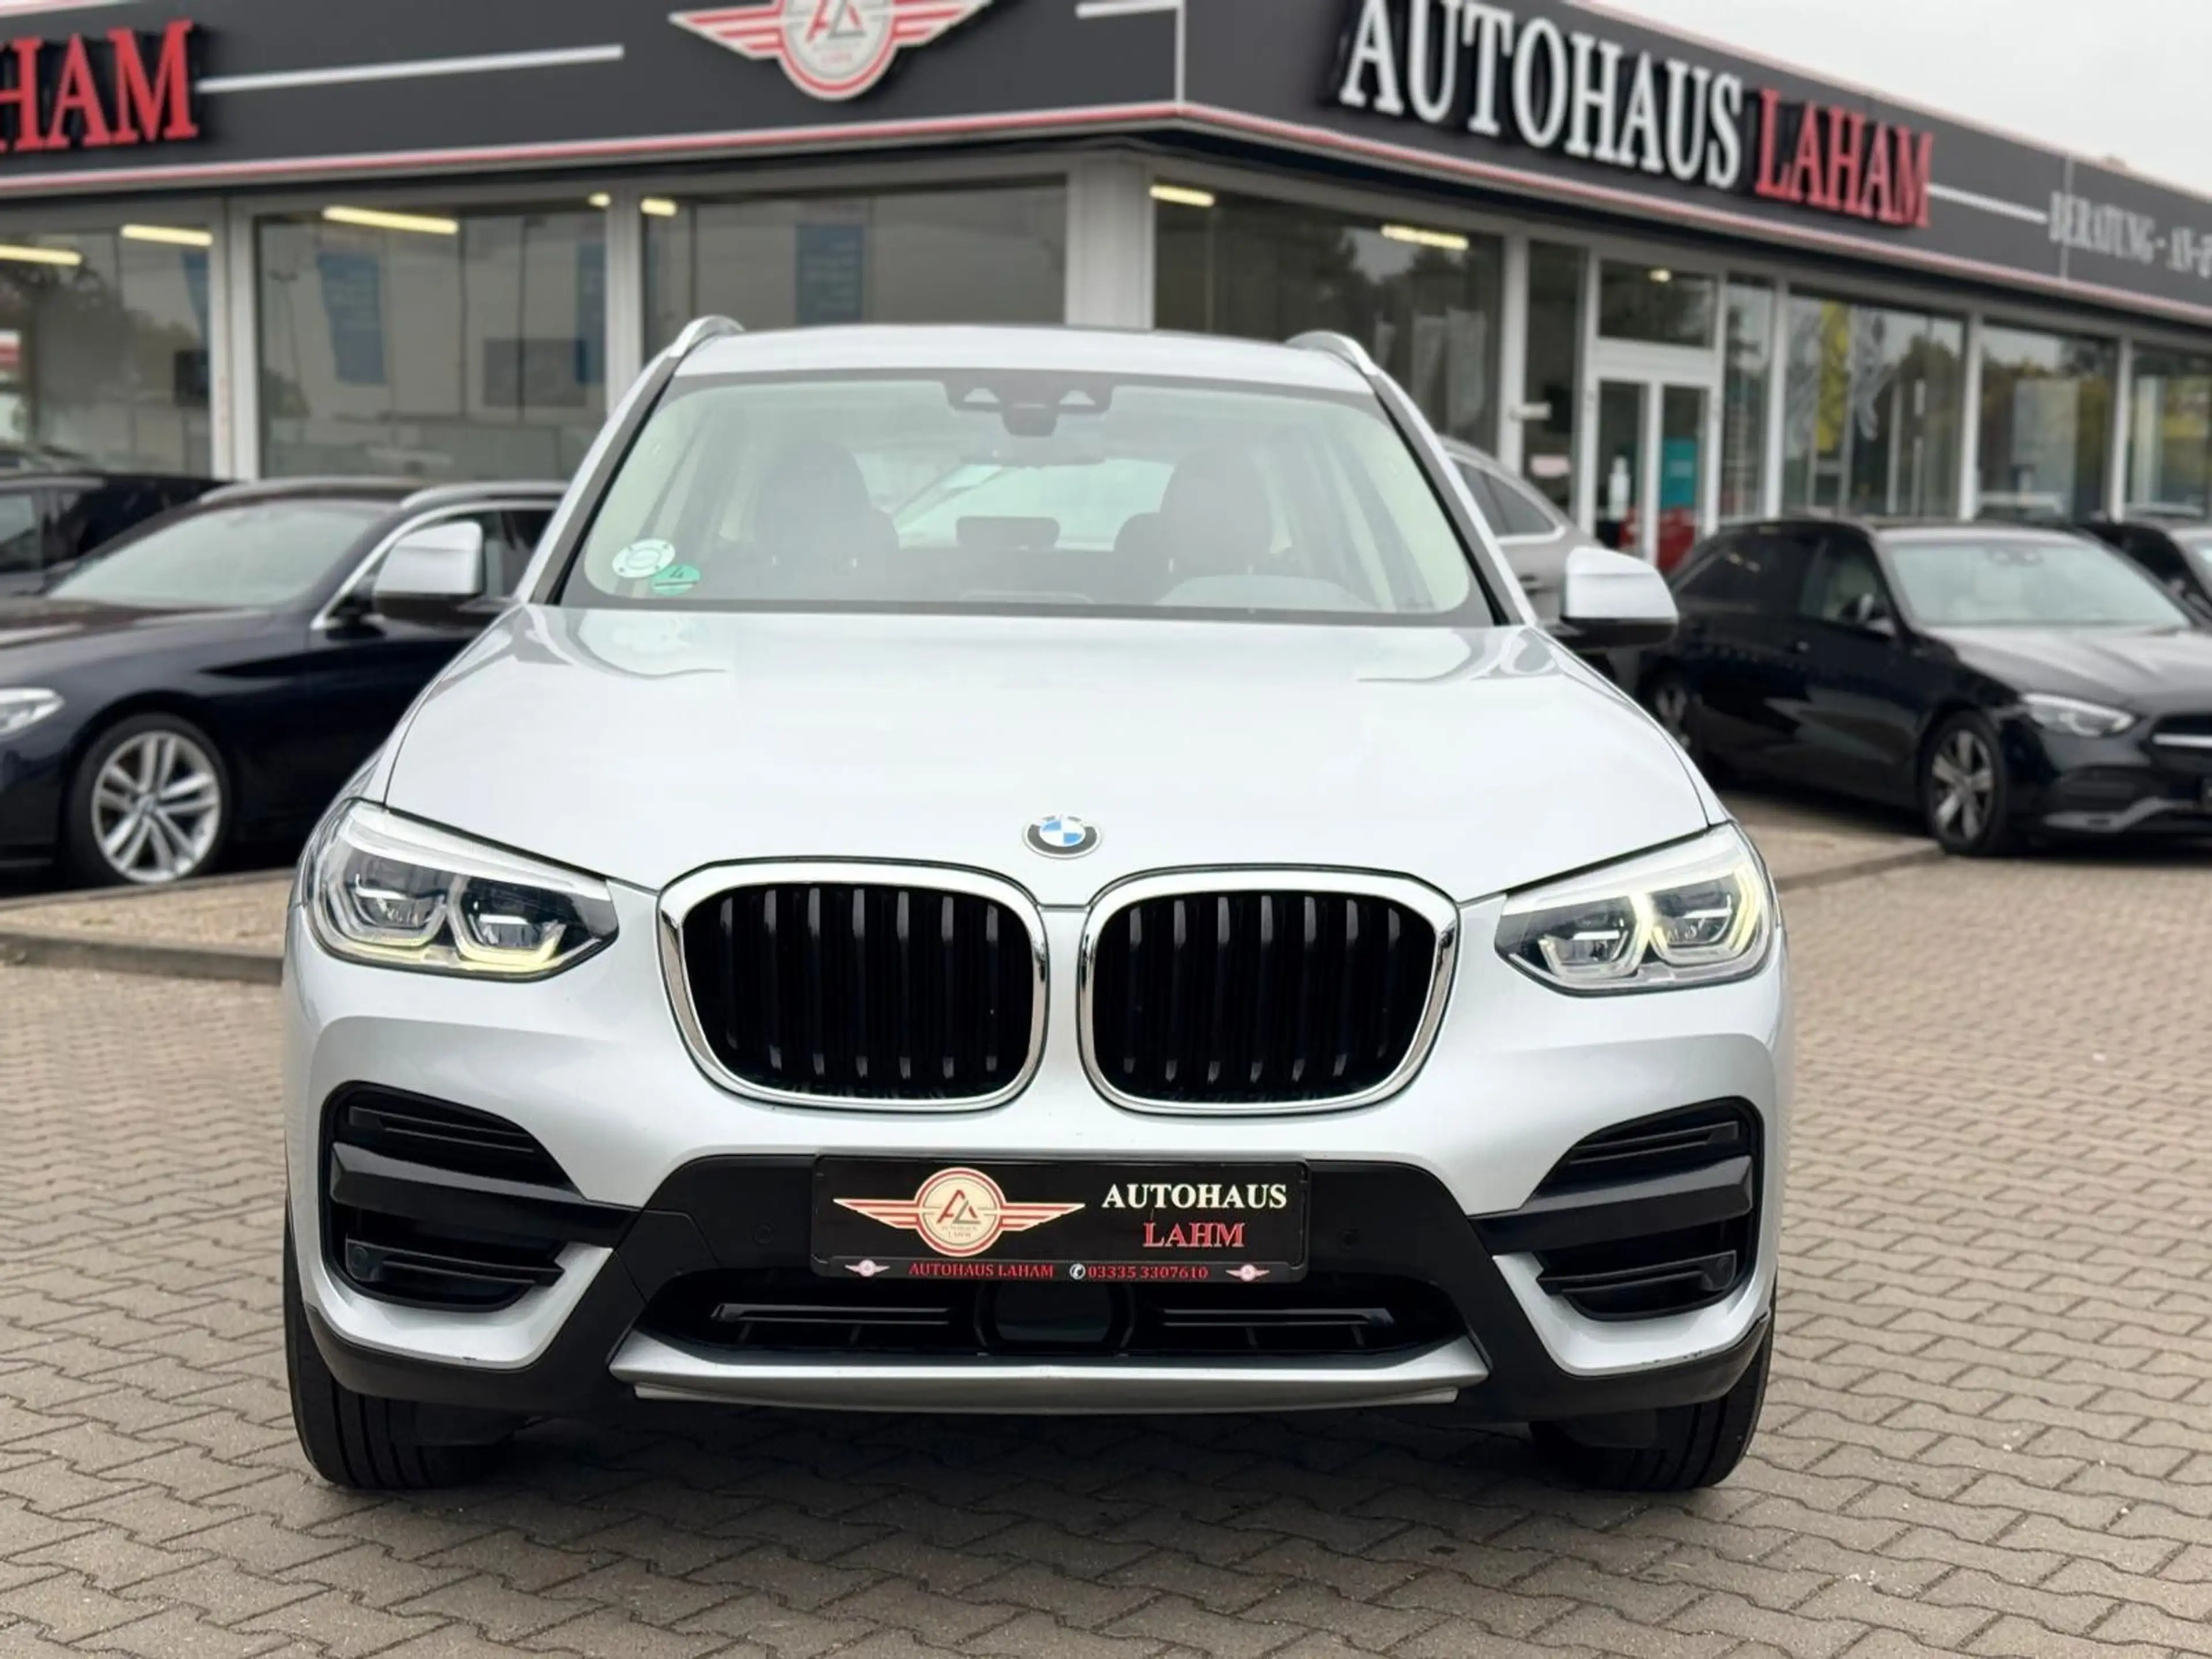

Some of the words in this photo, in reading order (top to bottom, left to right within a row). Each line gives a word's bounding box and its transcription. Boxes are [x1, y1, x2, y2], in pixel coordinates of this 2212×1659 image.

[1339, 0, 1742, 188] AUTOHAUS
[1755, 88, 1934, 228] LAHAM
[1101, 1183, 1287, 1209] AUTOHAUS
[1143, 1222, 1245, 1248] LAHM
[908, 1262, 994, 1277] AUTOHAUS
[998, 1264, 1054, 1278] LAHAM
[1088, 1266, 1137, 1279] 03335
[1140, 1266, 1209, 1279] 3307610
